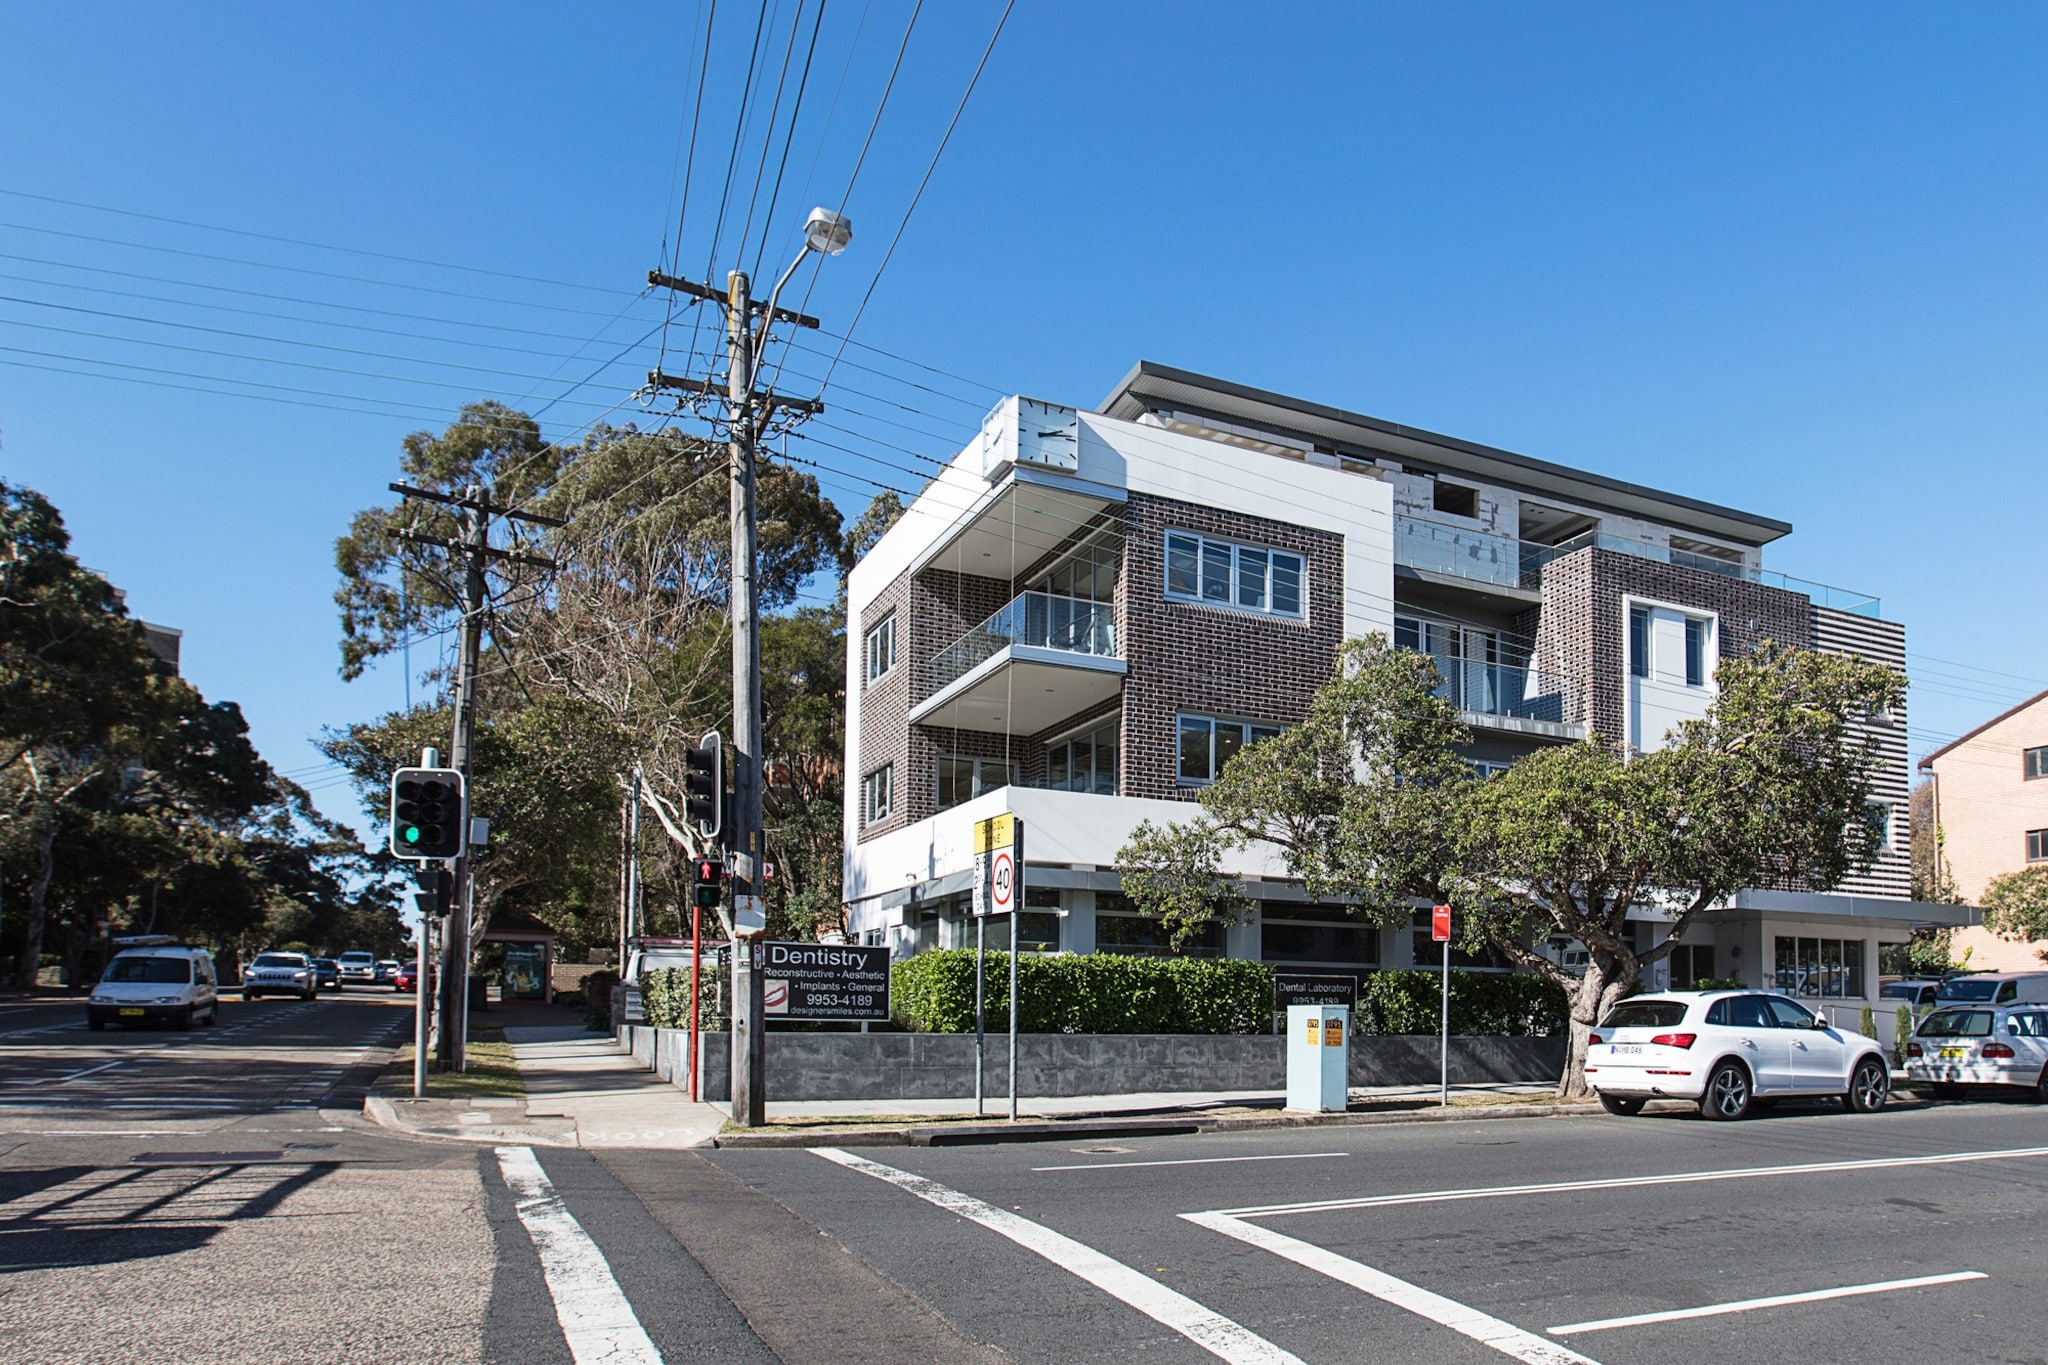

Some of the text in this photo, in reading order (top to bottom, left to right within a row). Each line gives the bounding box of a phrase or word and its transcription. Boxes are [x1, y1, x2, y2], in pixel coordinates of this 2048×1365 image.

[996, 867, 1010, 890] 40
[772, 946, 868, 970] Dentistry
[765, 968, 886, 980] Reconstructive Aesthetic
[800, 981, 885, 992] Implants General
[1279, 982, 1352, 994] Dental Laboratory
[806, 993, 873, 1006] 9953-4189
[790, 1006, 884, 1017] designersmiles.com.au
